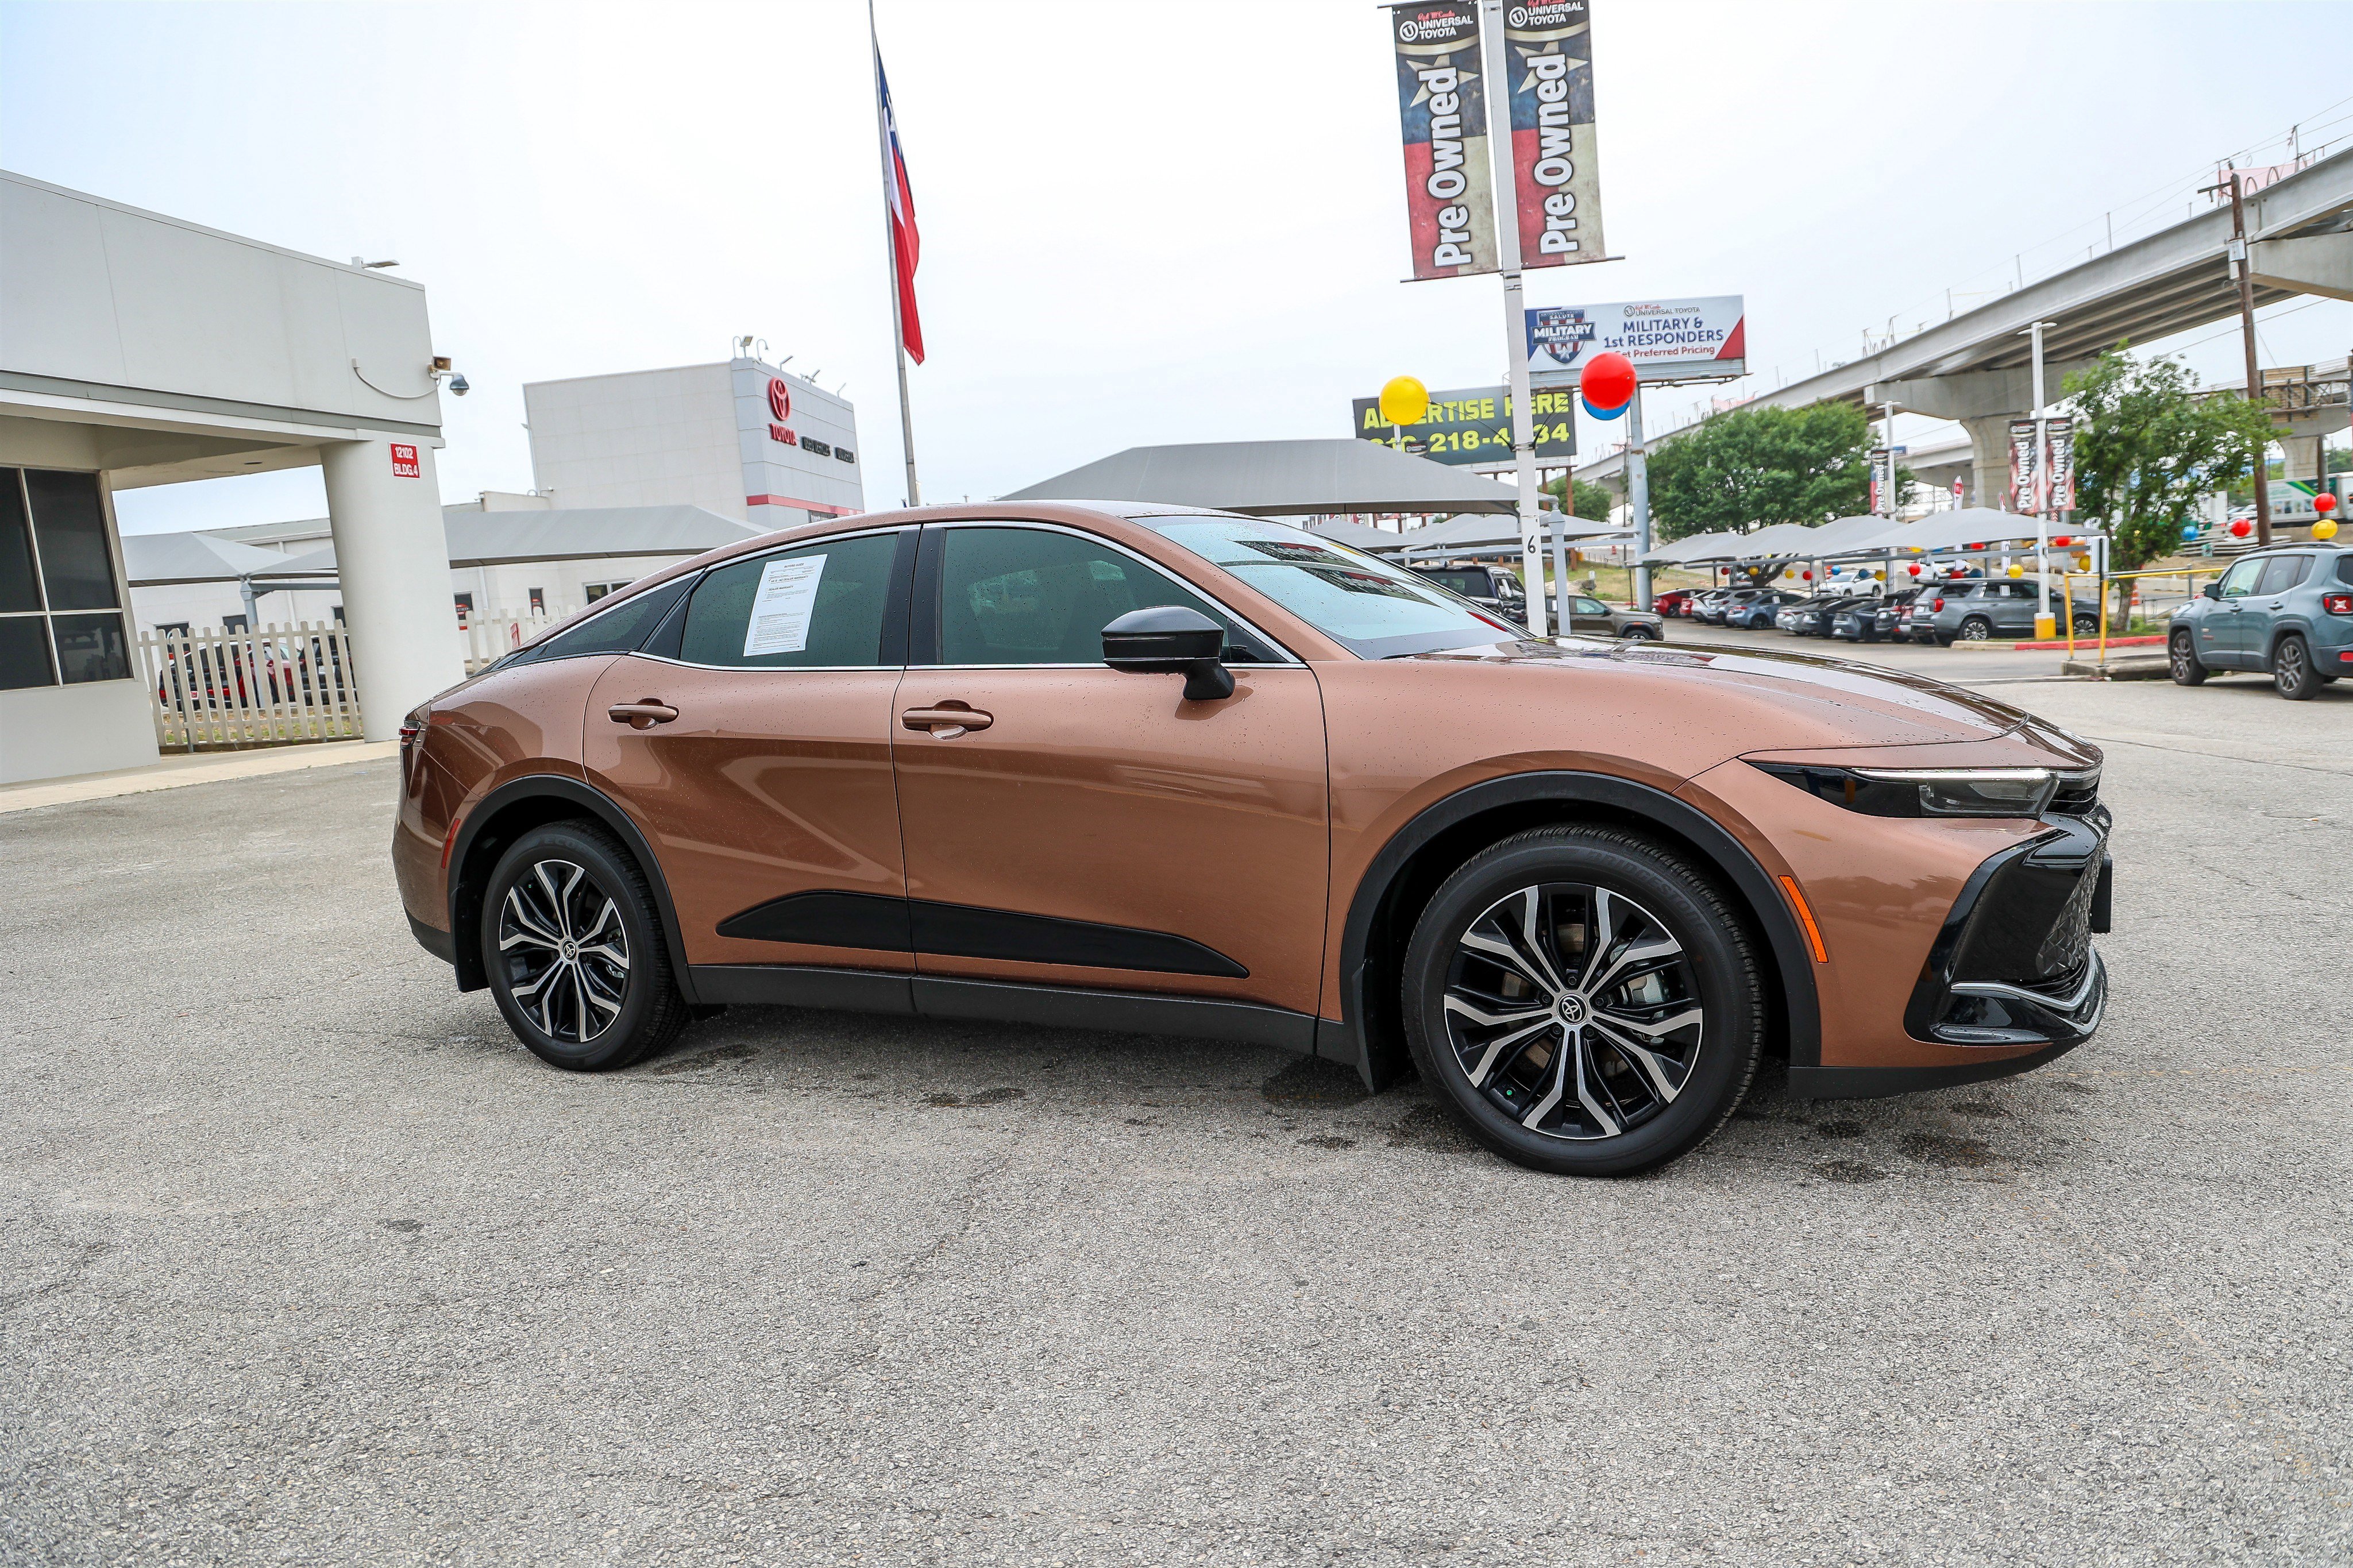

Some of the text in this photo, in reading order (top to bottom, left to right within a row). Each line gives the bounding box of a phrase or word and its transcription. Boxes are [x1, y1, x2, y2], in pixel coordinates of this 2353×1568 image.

[1528, 1, 1584, 16] UNIVERSAL
[1418, 15, 1475, 30] UNIVERSAL
[1528, 13, 1567, 26] TOYOTA
[1418, 26, 1457, 40] TOYOTA
[1526, 53, 1579, 254] Pre Owned
[1418, 67, 1472, 267] Pre Owned
[1533, 323, 1592, 338] MILITARY
[1623, 316, 1704, 333] MILITARY &
[1604, 329, 1724, 348] 1st RESPONDERS
[1634, 346, 1679, 358] Preferred
[1681, 345, 1715, 356] Pricing
[769, 422, 797, 446] TOYOTA
[1429, 422, 1570, 453] 218-434
[395, 446, 414, 459] 12102
[2050, 439, 2066, 484] Owned
[2014, 441, 2031, 486] Owned
[1875, 464, 1885, 495] Owned
[2016, 487, 2032, 509] Pre
[2051, 485, 2067, 507] Pre
[1527, 535, 1537, 554] 6
